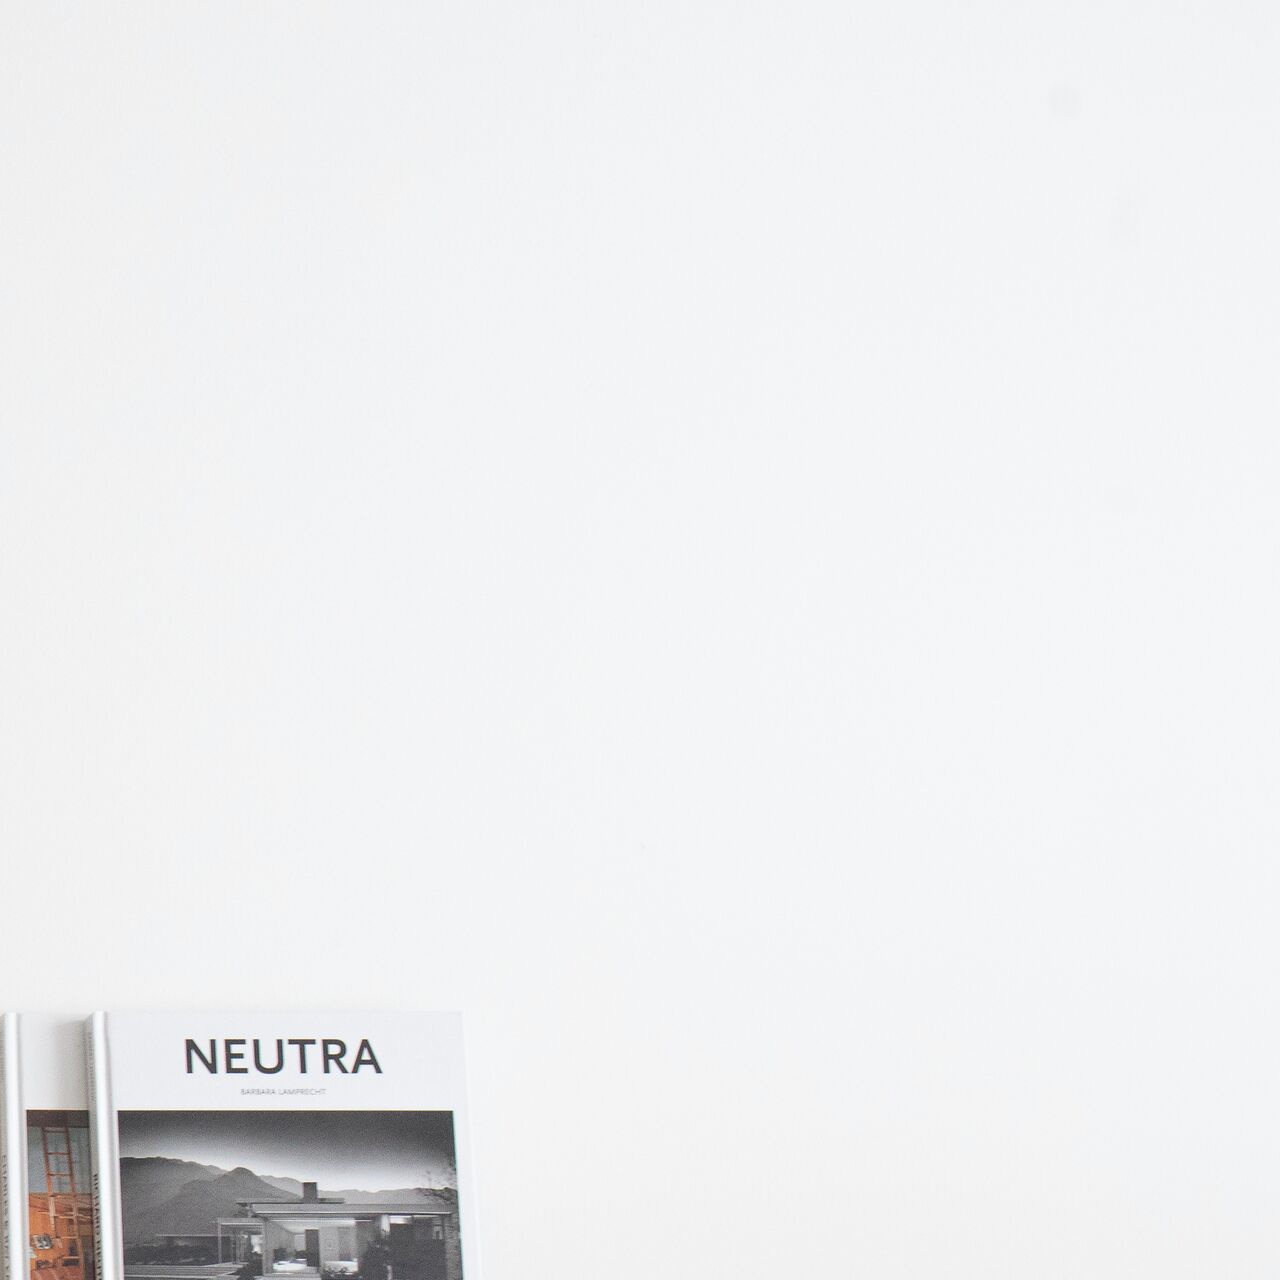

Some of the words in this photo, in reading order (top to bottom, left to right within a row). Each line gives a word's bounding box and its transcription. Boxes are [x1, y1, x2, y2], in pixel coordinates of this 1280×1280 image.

[185, 1038, 383, 1074] NEUTRA
[240, 1088, 276, 1096] BARBARA
[278, 1088, 327, 1096] LAMPRECHT
